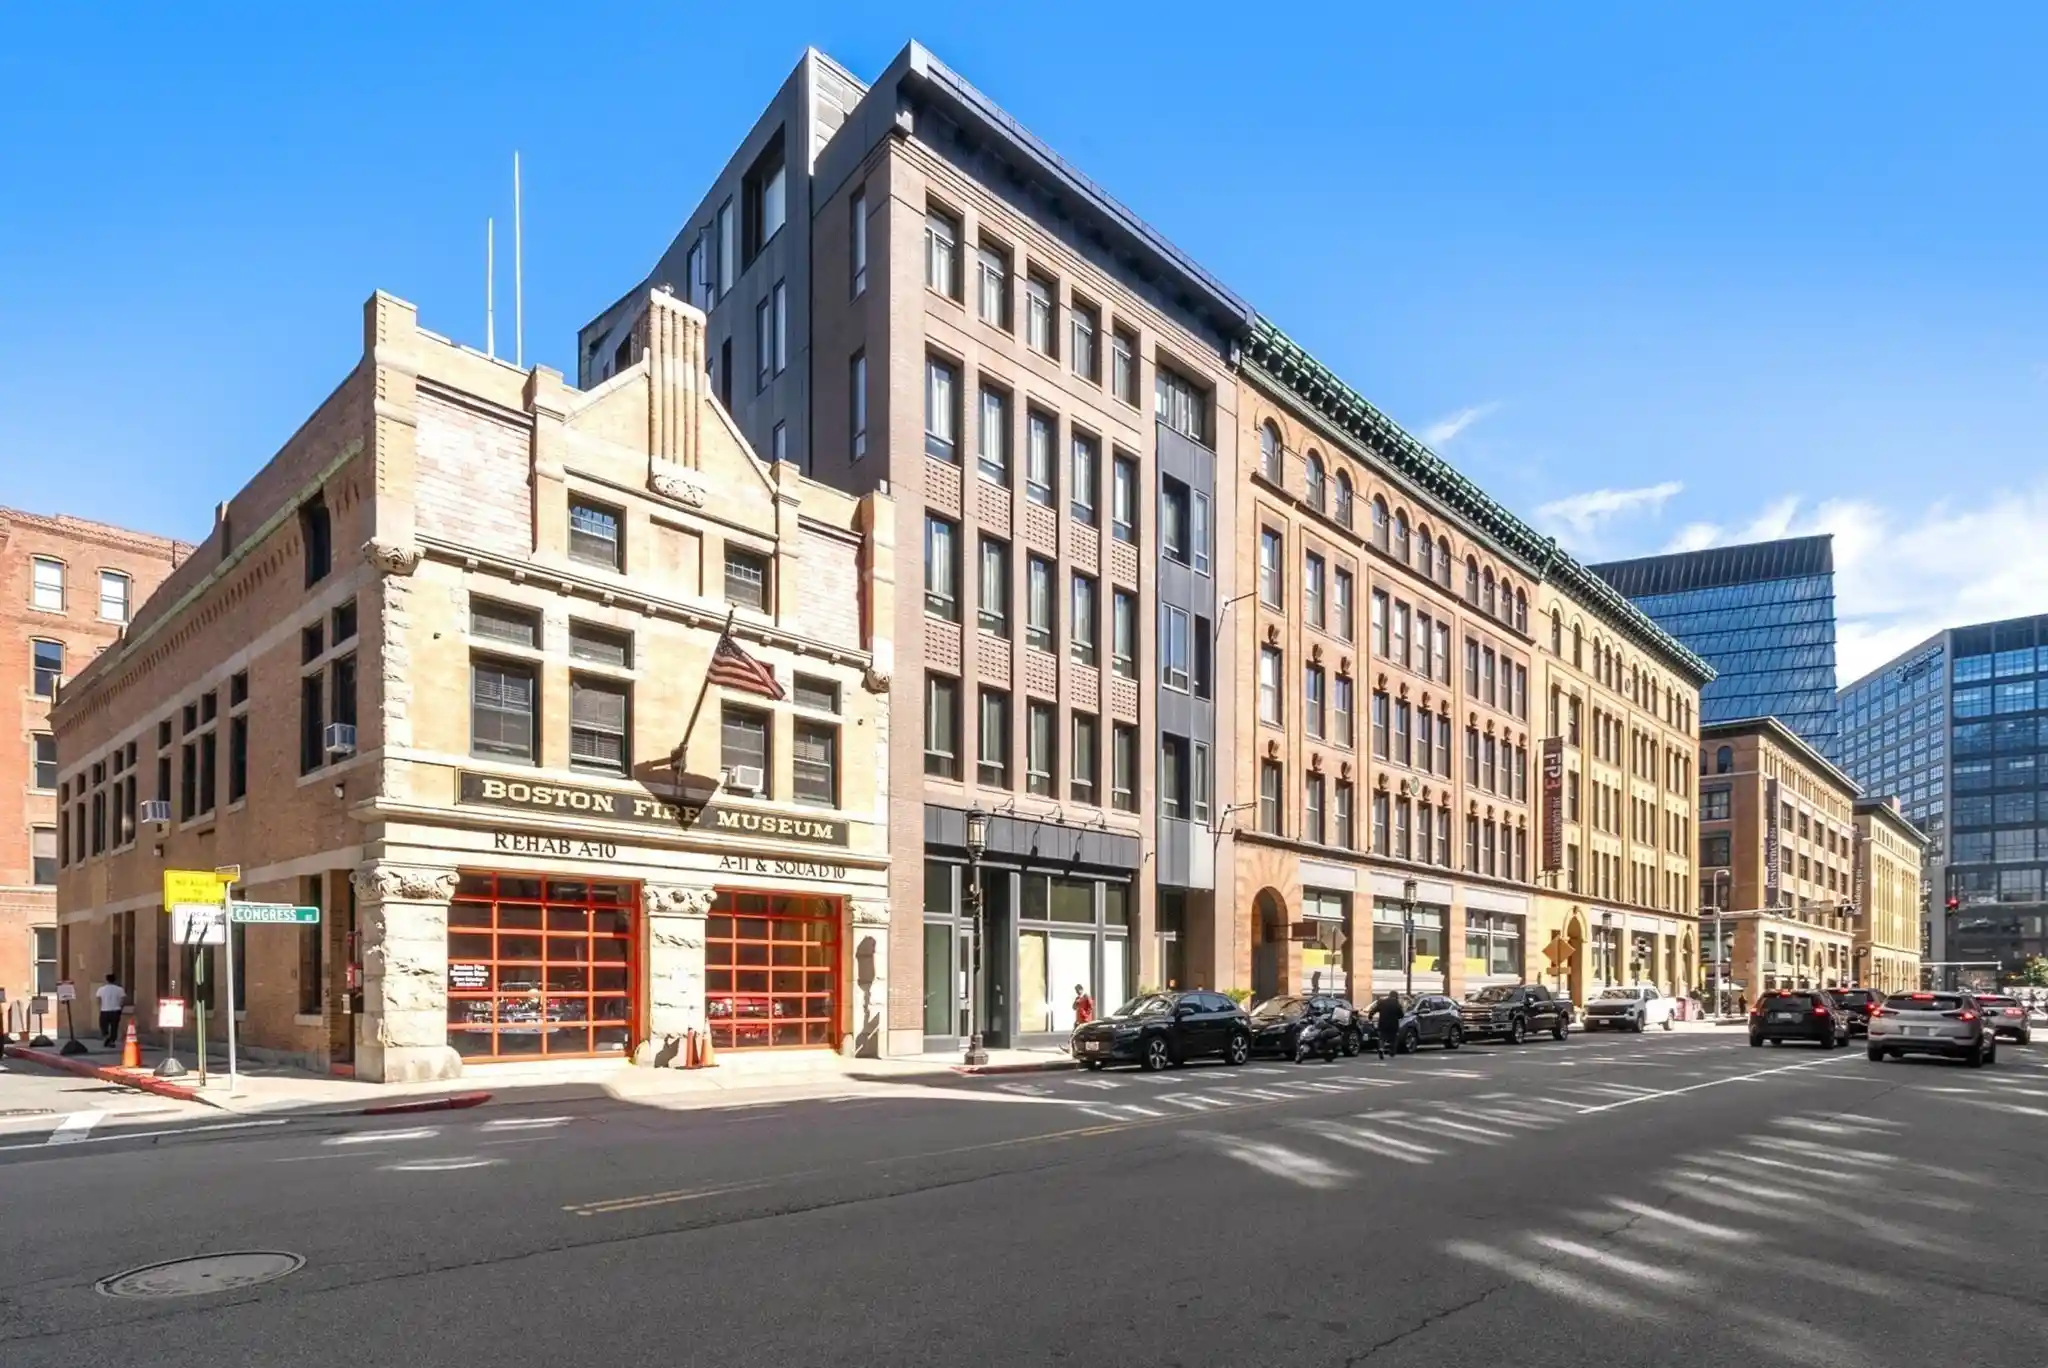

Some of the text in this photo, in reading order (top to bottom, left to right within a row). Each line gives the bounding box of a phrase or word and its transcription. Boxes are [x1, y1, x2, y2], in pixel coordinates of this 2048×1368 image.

[482, 779, 834, 840] BOSTON FIRE MUSEUM
[494, 831, 617, 859] REHAB A-10
[718, 855, 846, 879] A-11 & SQUAD 10
[1767, 840, 1777, 889] Residence
[236, 908, 297, 921] CONGRESS
